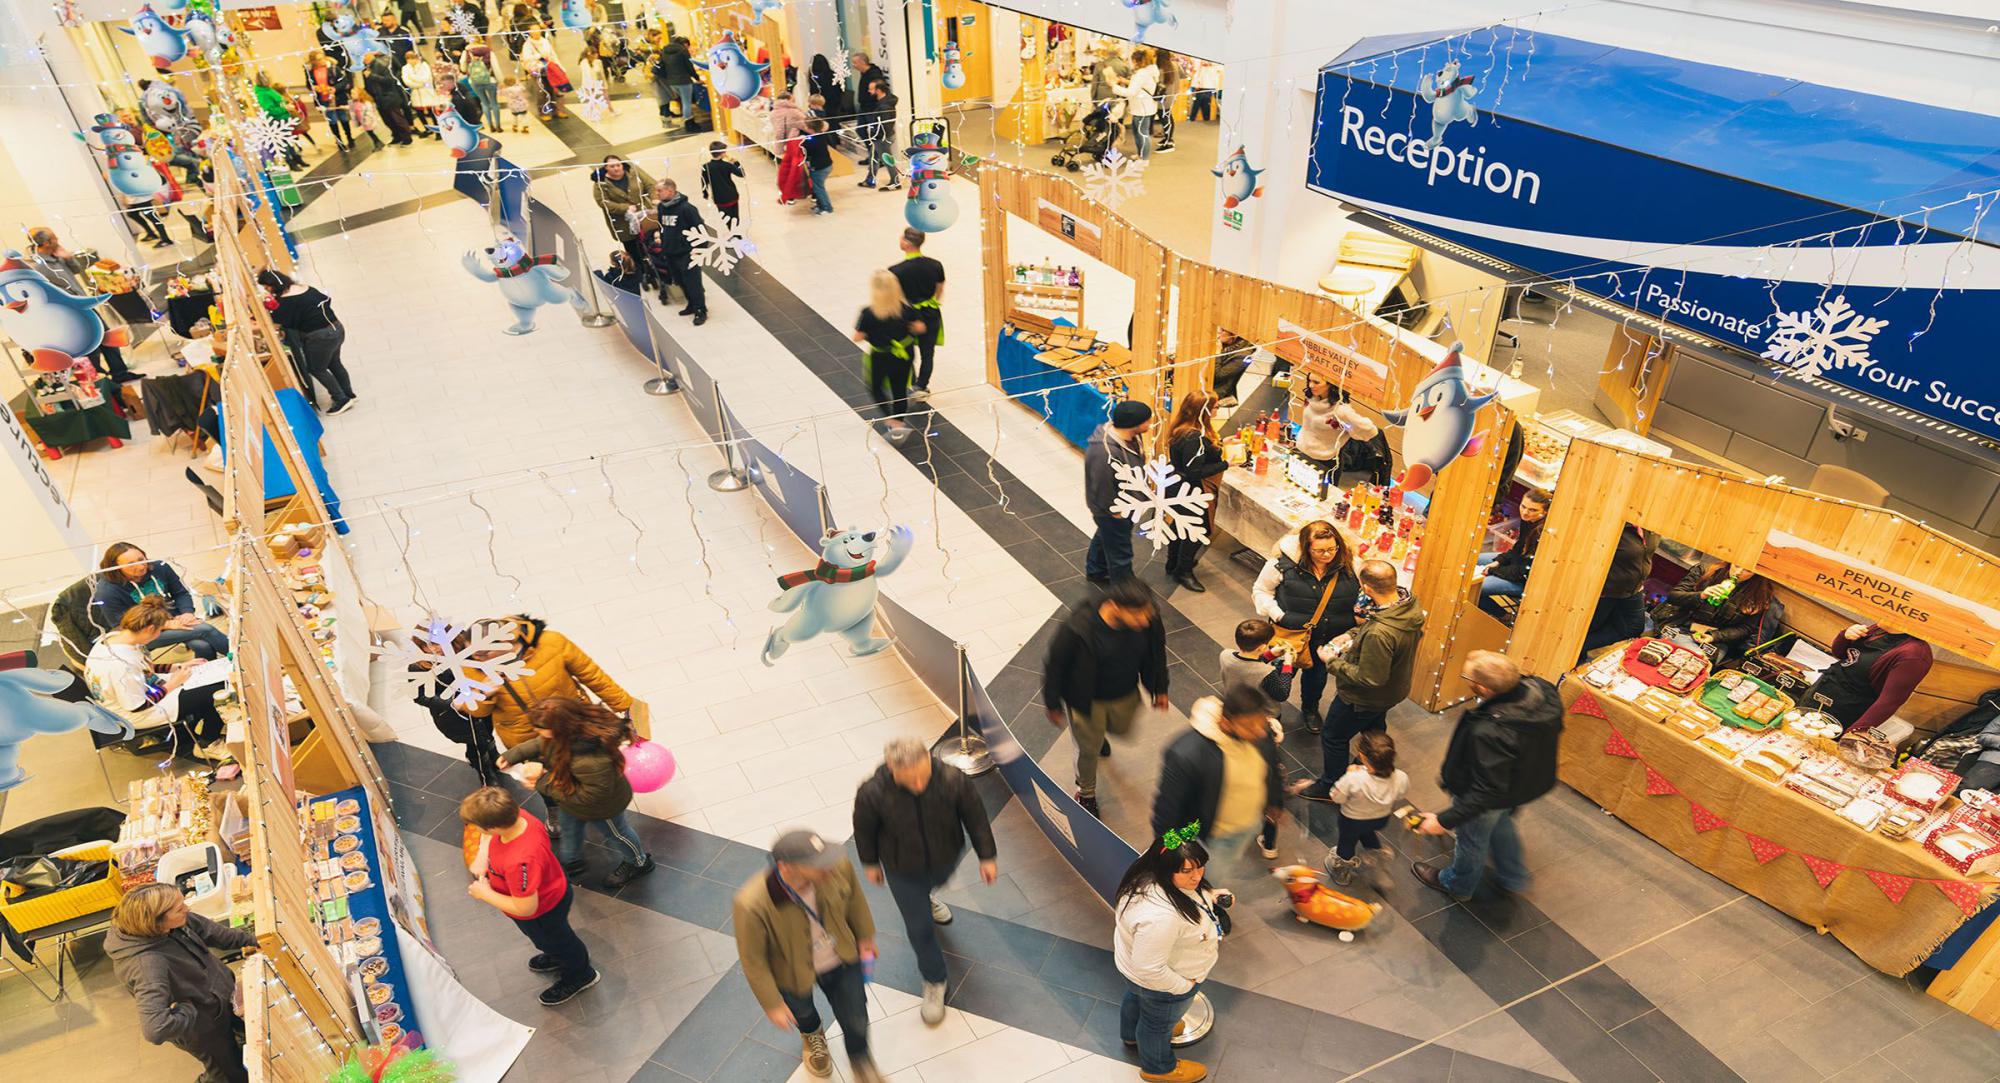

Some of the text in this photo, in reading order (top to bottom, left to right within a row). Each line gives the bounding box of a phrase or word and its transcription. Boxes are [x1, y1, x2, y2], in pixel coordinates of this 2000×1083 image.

[1340, 105, 1541, 205] Reception
[1646, 284, 1761, 339] Passionate
[1856, 356, 1921, 393] Your
[0, 402, 72, 529] Lecture
[1815, 572, 1931, 623] PAT-A-CAKES
[1843, 569, 1913, 602] PENDLE
